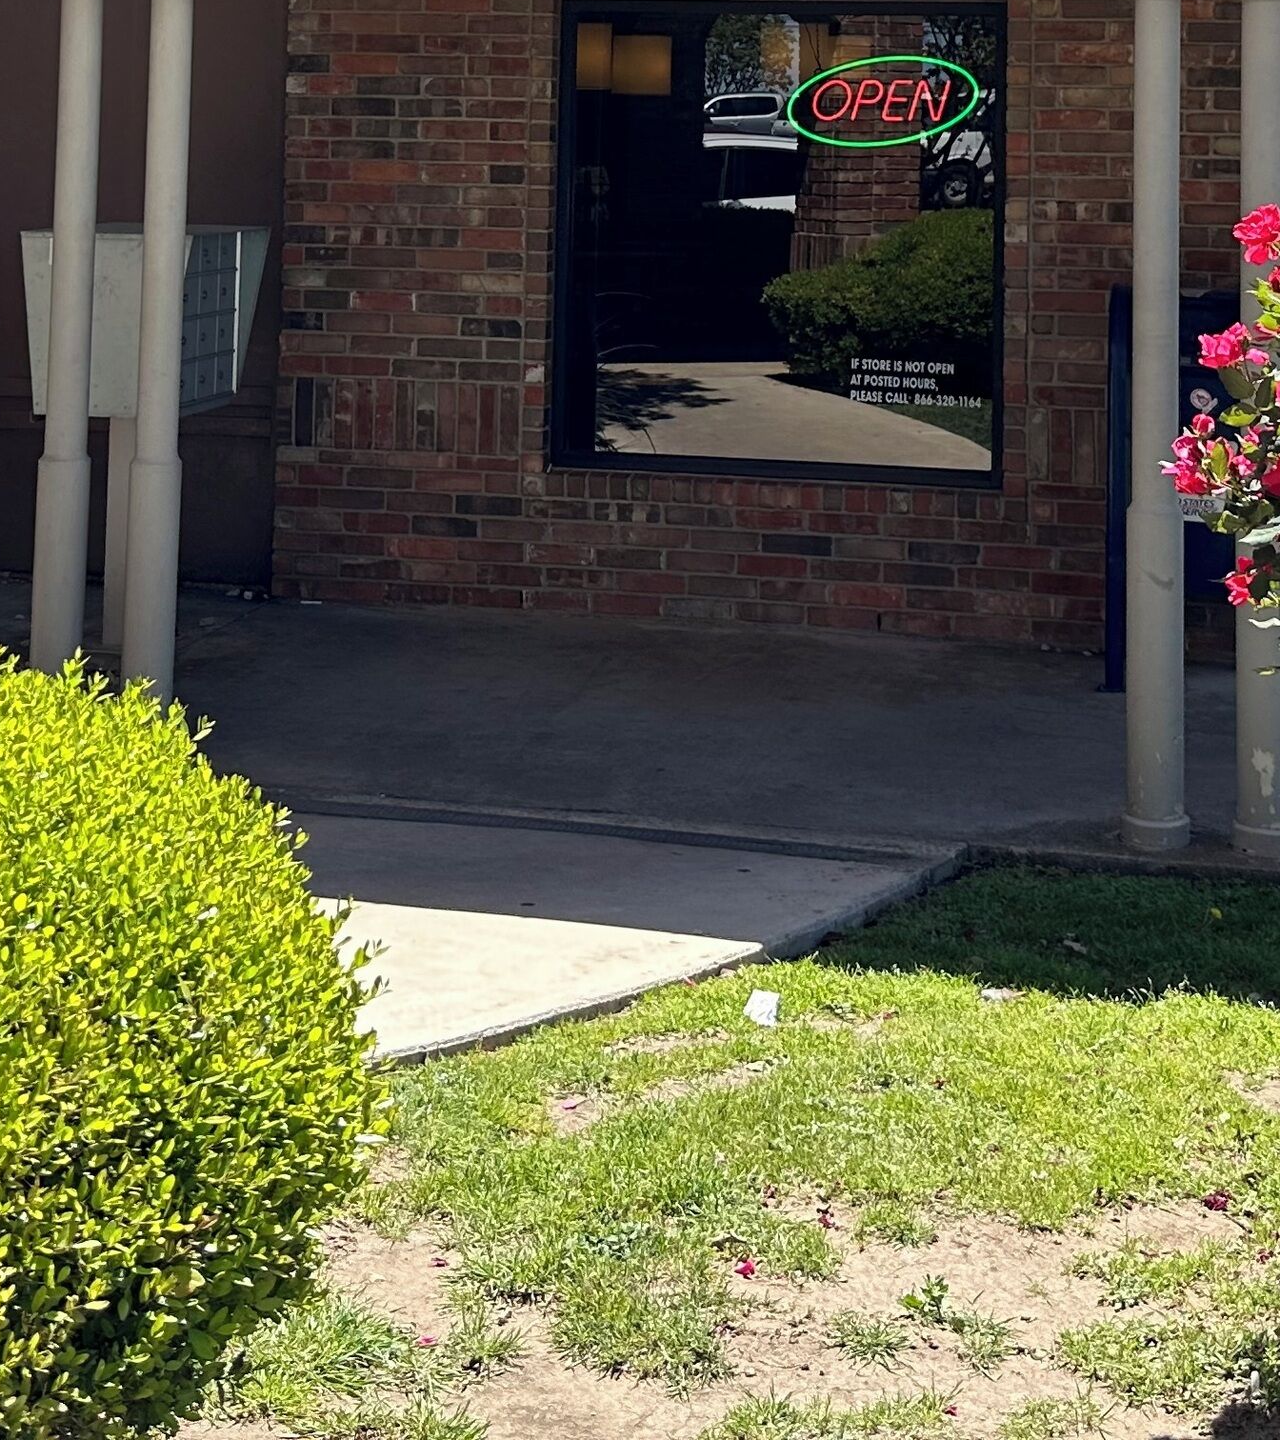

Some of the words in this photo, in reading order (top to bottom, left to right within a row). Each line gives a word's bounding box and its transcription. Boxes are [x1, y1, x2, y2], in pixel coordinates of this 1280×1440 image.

[812, 79, 951, 122] OPEN
[851, 358, 860, 370] IF
[862, 359, 891, 371] STORE
[894, 360, 902, 372] IS
[905, 361, 925, 373] NOT
[927, 362, 955, 375] OPEN
[850, 374, 861, 385] AT
[864, 375, 900, 387] POSTED
[903, 377, 938, 391] HOURS,
[850, 390, 882, 403] PLEASE
[914, 393, 981, 408] 866-320-1164
[1182, 498, 1215, 507] STATES
